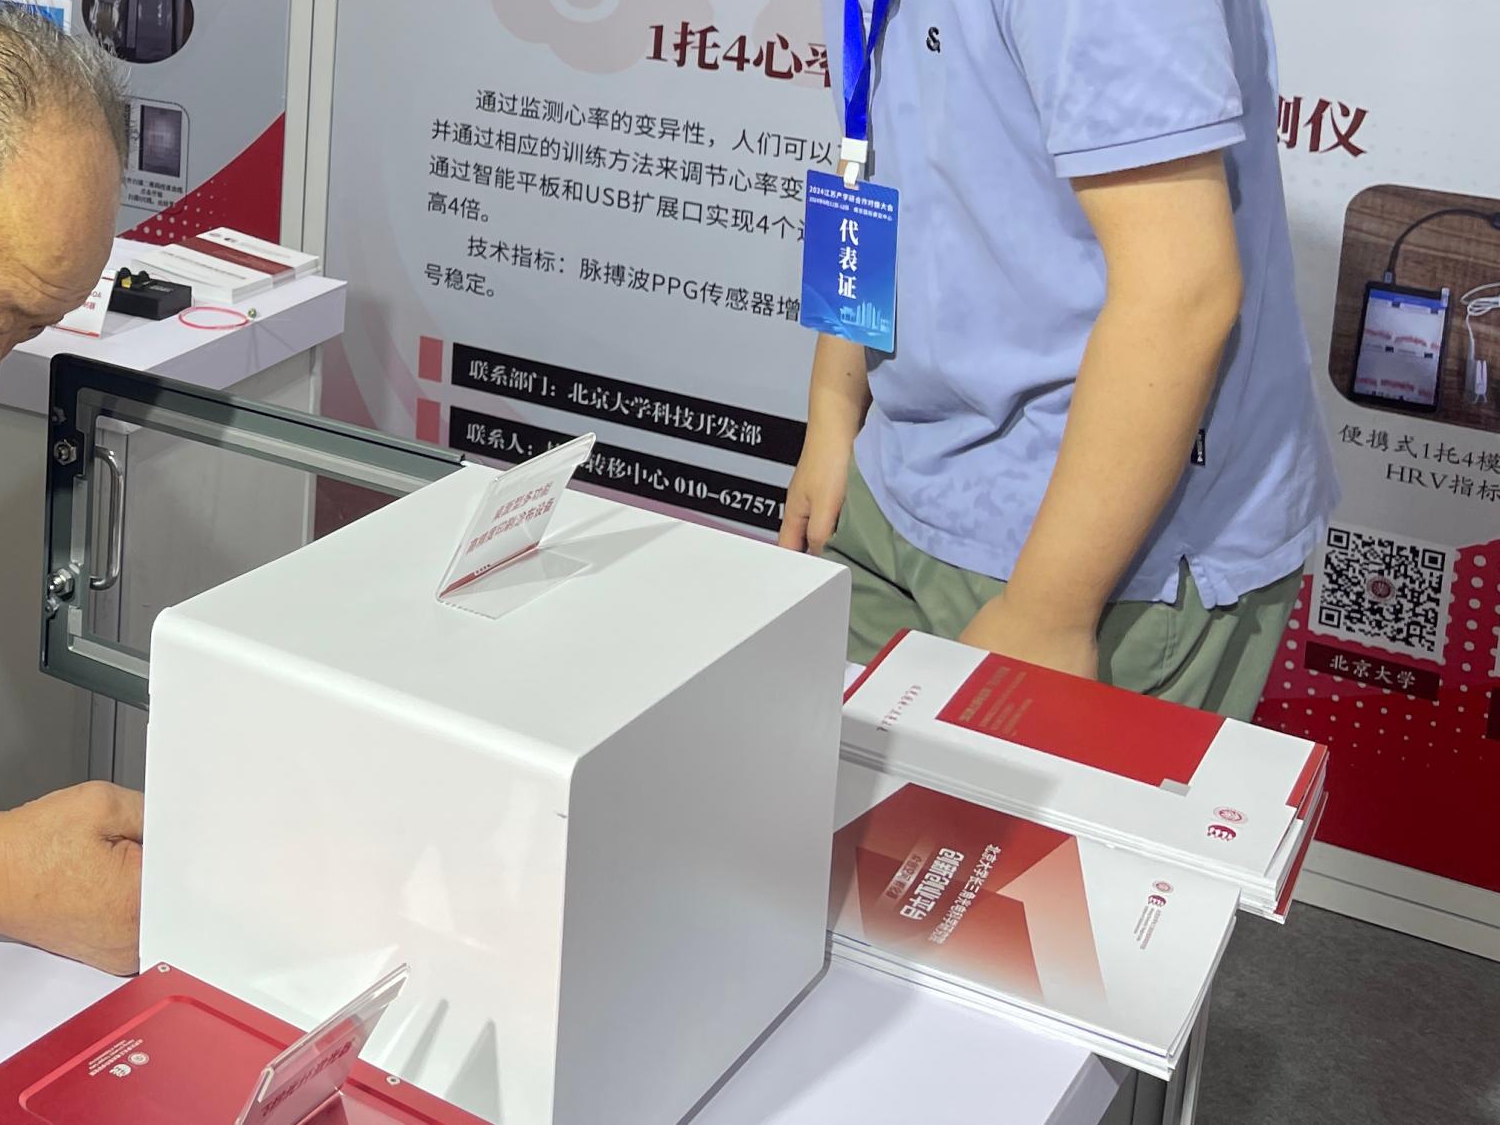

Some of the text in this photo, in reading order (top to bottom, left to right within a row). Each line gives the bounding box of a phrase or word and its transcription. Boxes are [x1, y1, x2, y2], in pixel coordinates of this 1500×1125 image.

[426, 191, 492, 223] 高4倍。
[837, 218, 860, 300] 代表证
[424, 262, 498, 299] 号稳定。
[1329, 654, 1416, 689] 北京大学
[899, 847, 964, 920] 创新创业平台
